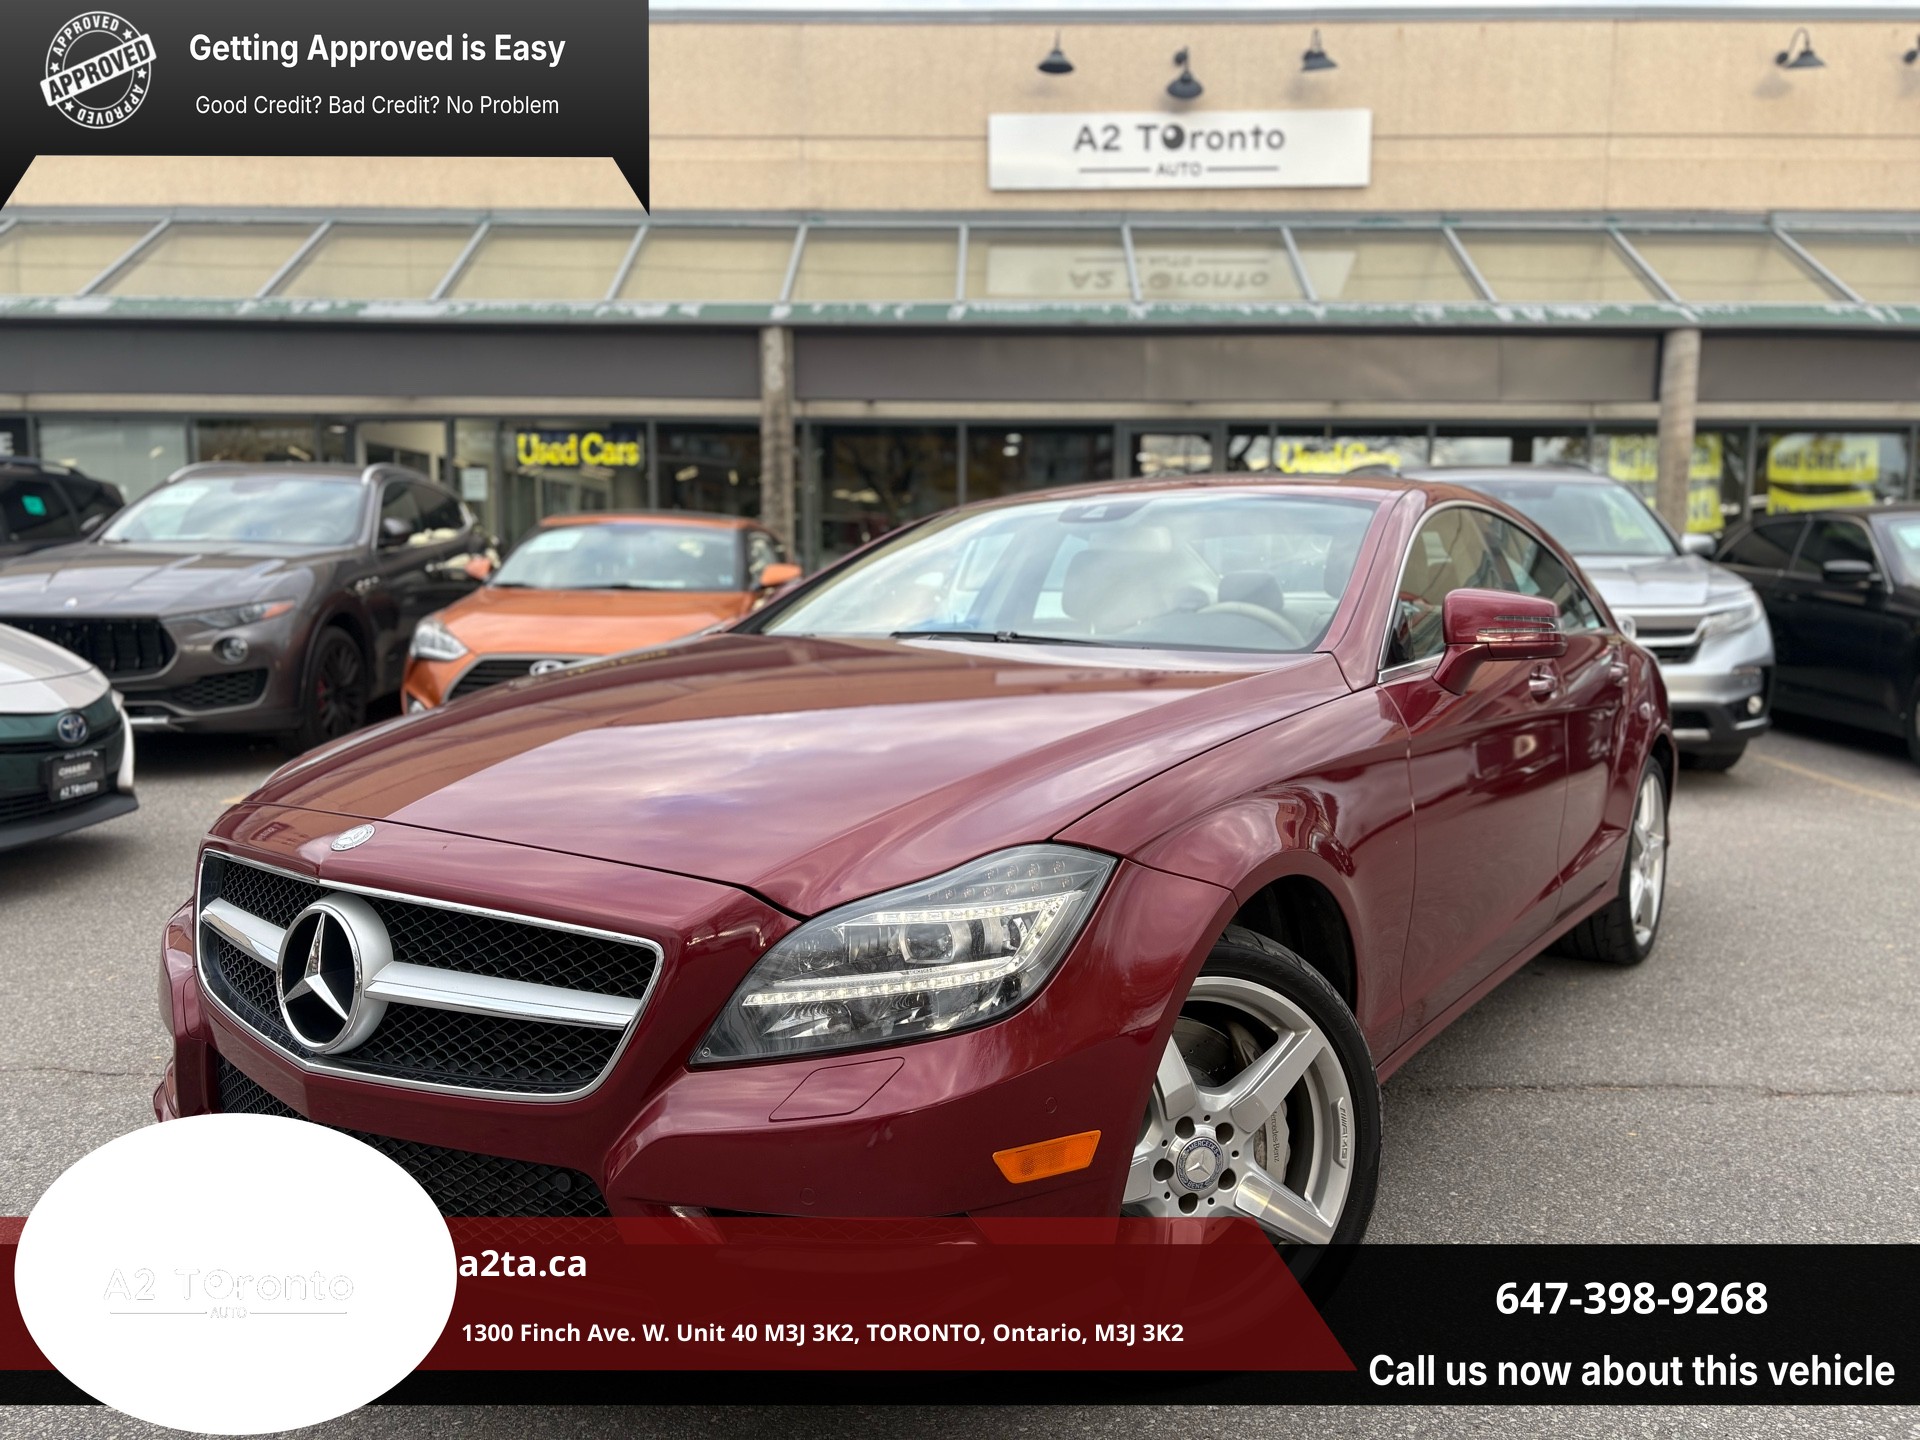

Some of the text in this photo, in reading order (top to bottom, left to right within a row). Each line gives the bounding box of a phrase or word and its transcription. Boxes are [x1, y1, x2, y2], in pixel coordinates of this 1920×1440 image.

[1074, 124, 1122, 151] A2
[1155, 161, 1202, 177] AUTO
[517, 431, 640, 467] Used Cars
